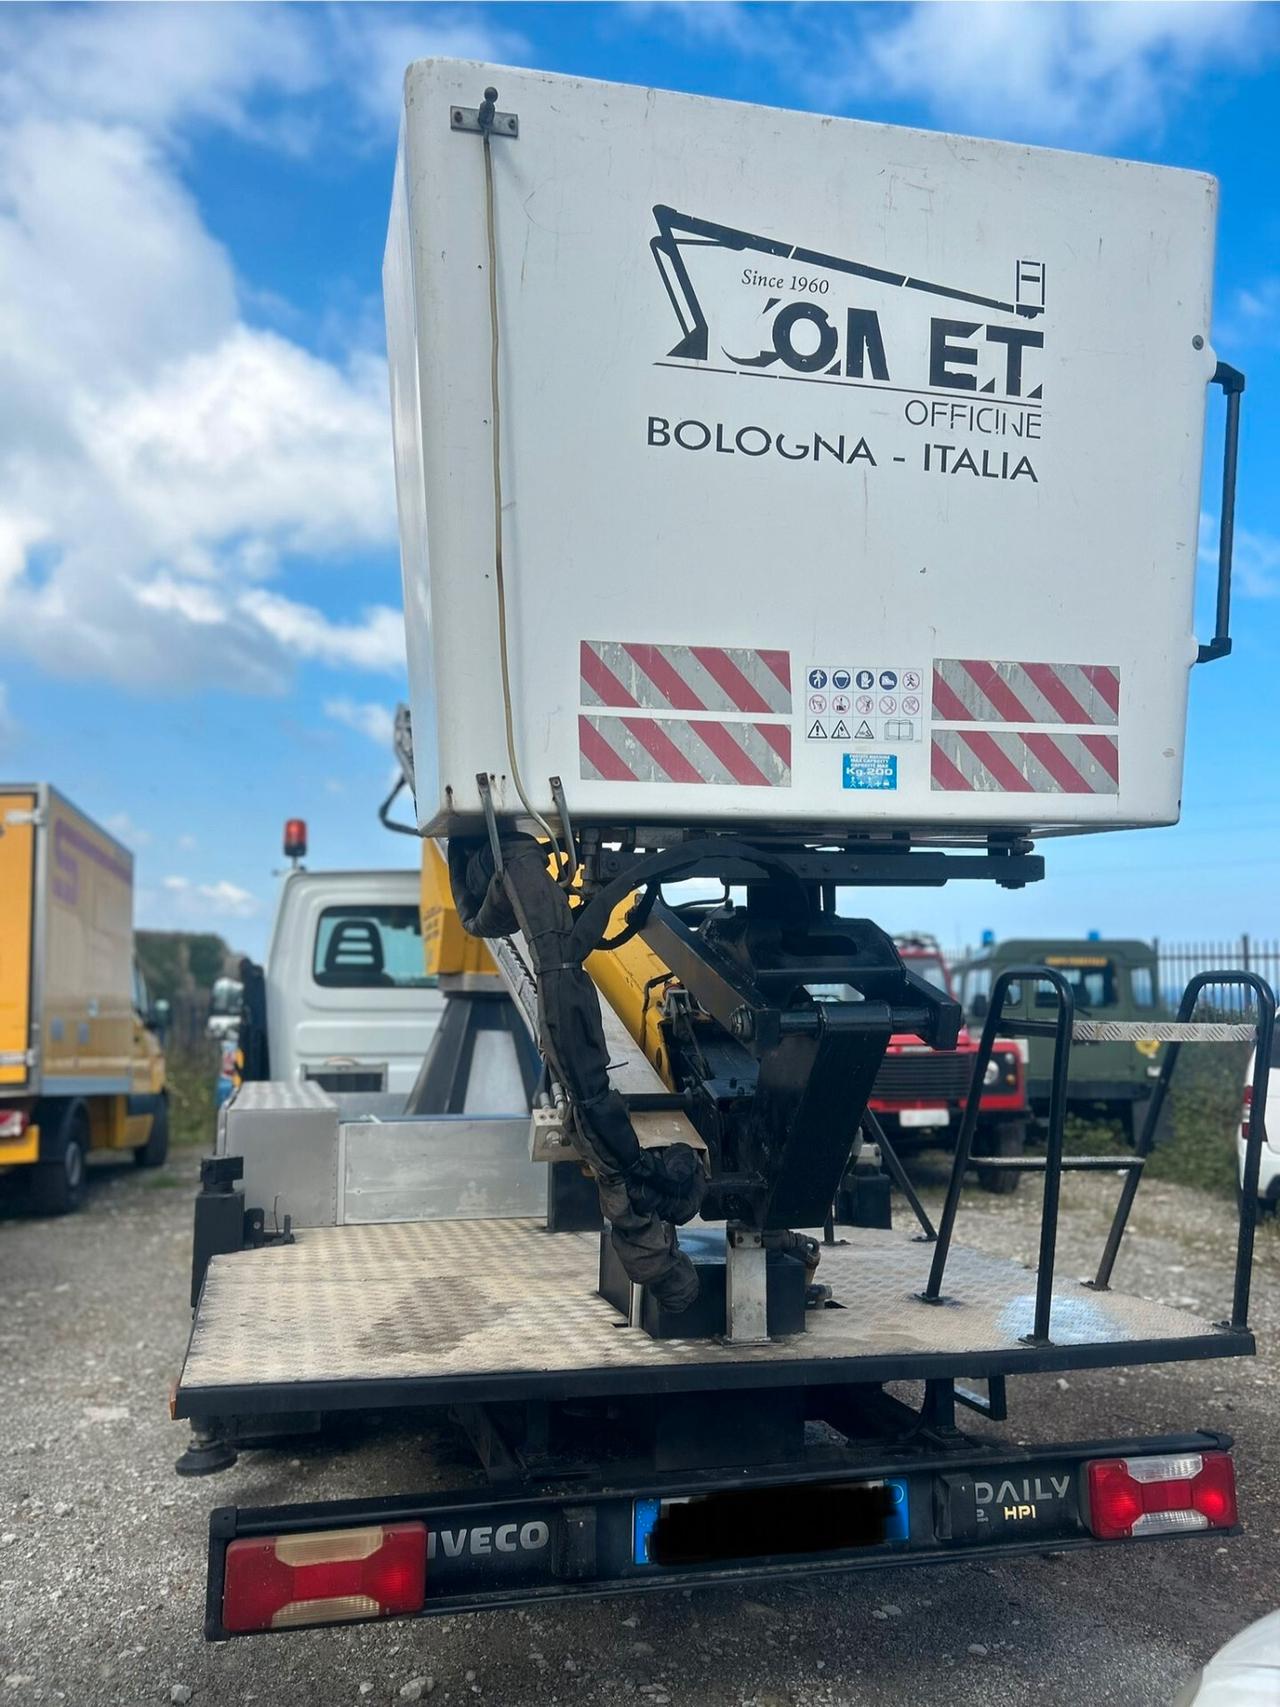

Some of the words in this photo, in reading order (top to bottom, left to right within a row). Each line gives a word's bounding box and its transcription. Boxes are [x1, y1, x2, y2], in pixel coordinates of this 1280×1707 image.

[742, 269, 784, 288] Since
[789, 275, 830, 294] 1960
[905, 399, 1042, 440] OFFICINE
[647, 416, 878, 467] BOLOGNA
[923, 443, 1040, 483] ITALIA
[974, 1475, 1071, 1505] DAILY
[1004, 1504, 1037, 1521] HPI
[427, 1520, 550, 1560] IVECO
